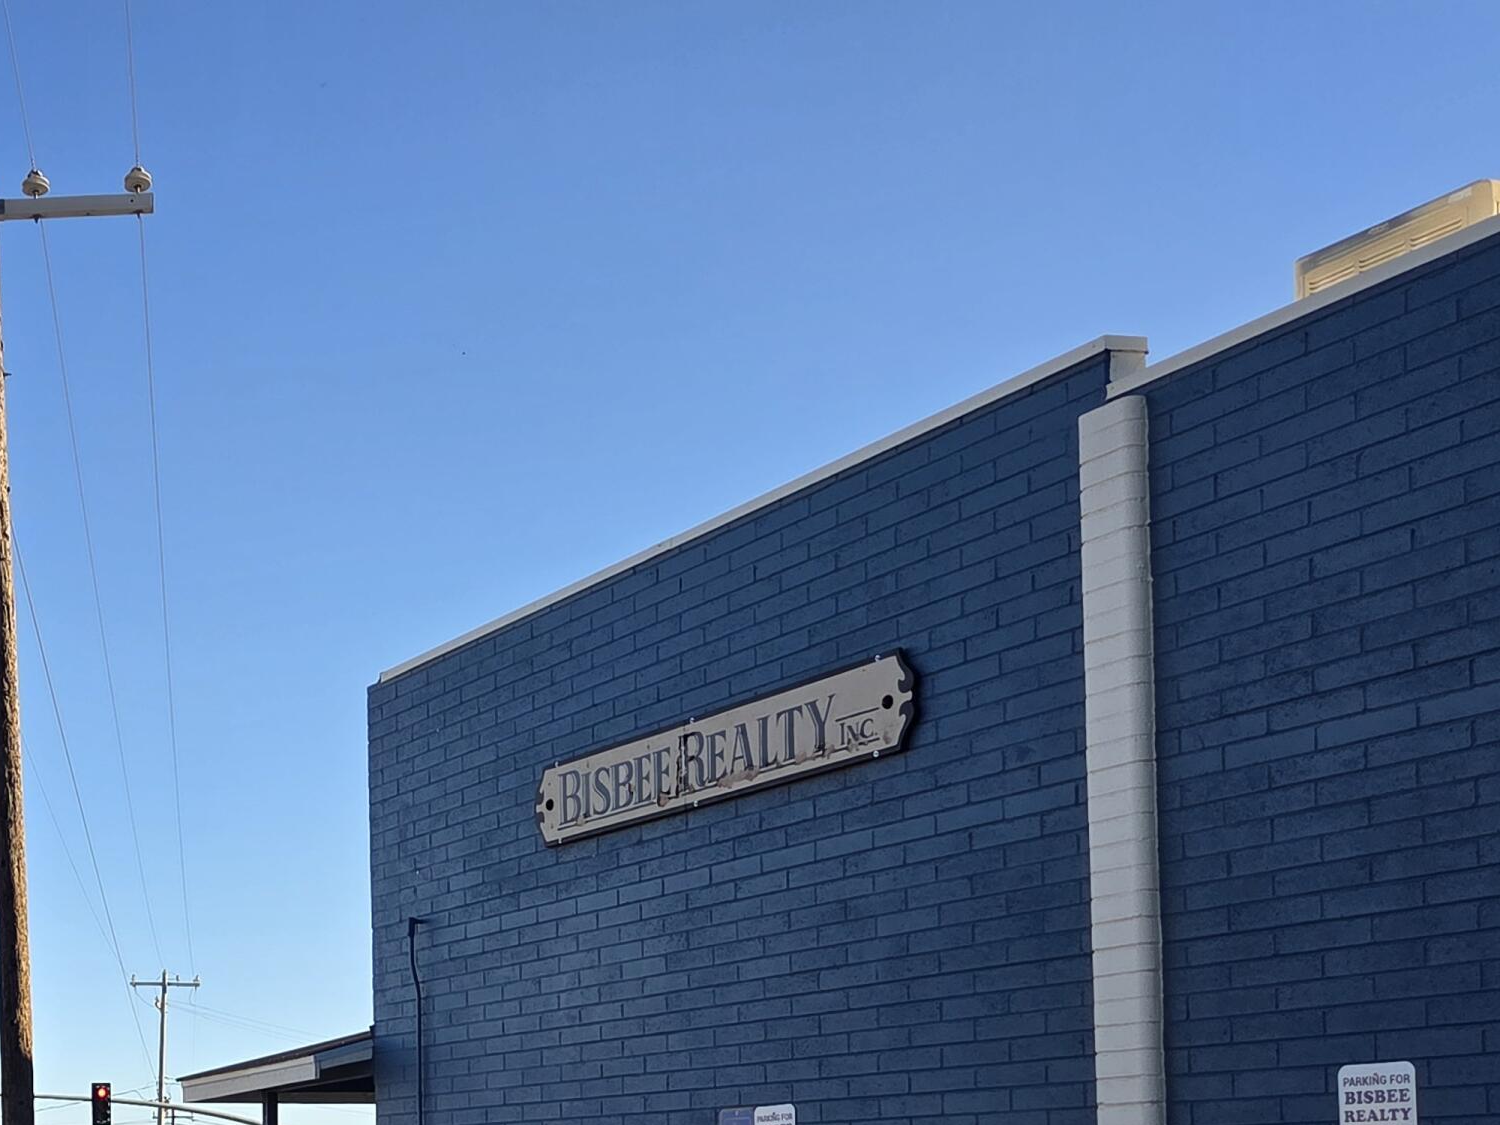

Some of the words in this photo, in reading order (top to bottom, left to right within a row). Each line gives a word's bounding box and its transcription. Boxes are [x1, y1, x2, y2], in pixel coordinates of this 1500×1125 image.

[558, 746, 672, 826] BISBEE
[678, 693, 836, 793] REALTY
[1343, 1075, 1387, 1087] PARKING
[1390, 1074, 1411, 1084] FOR
[1344, 1088, 1411, 1105] BISBEE
[1344, 1108, 1412, 1123] REALTY
